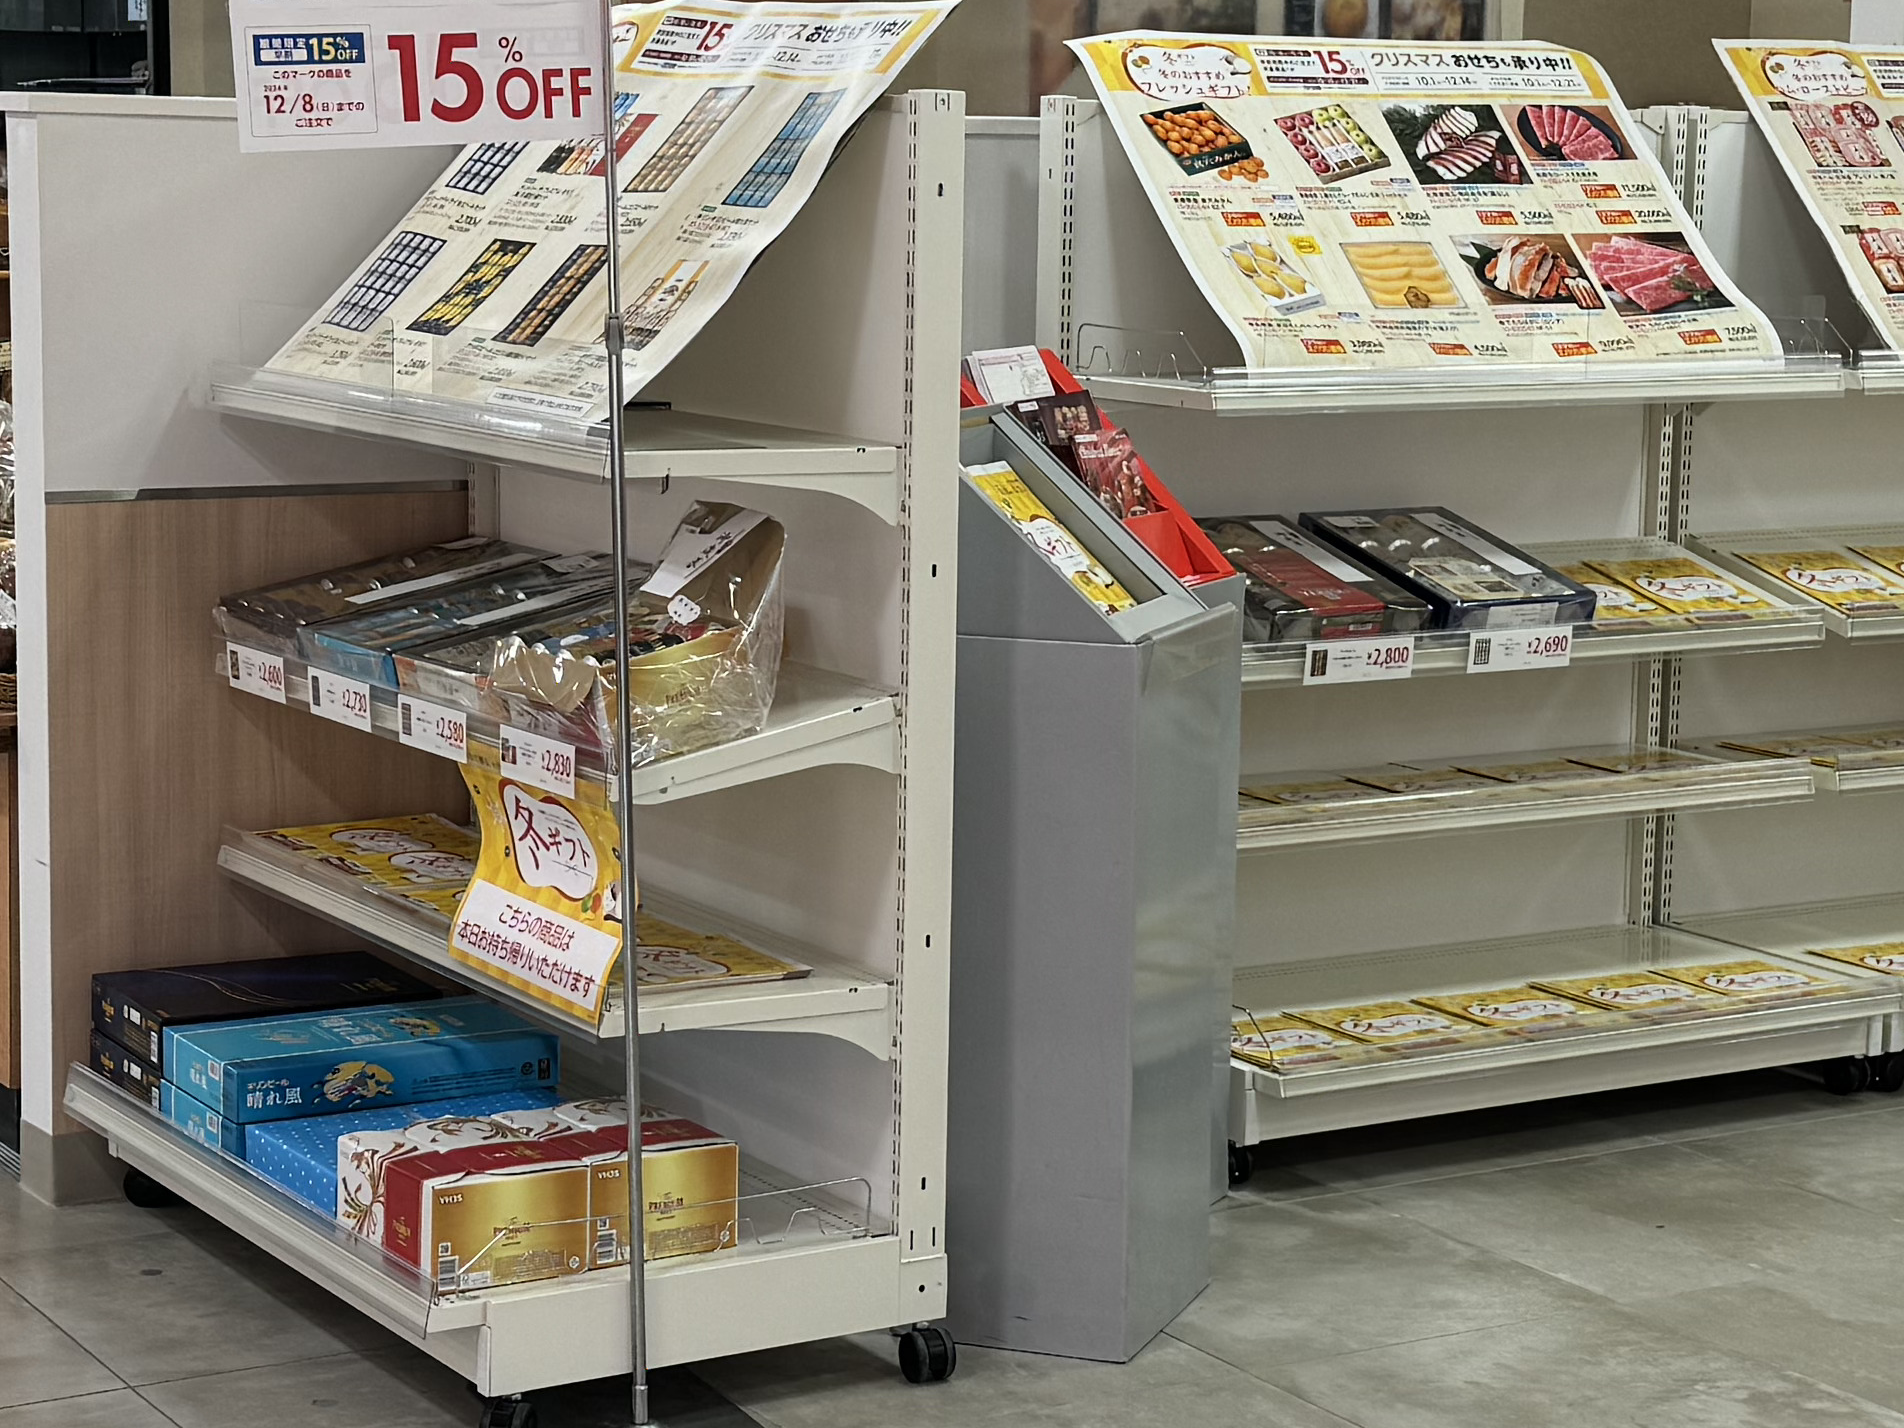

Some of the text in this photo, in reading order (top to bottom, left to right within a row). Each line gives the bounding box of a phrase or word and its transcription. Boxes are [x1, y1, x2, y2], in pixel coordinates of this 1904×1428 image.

[1140, 81, 1252, 98] フレッシュギフト!
[1158, 68, 1226, 81] 冬のおすすめ
[512, 794, 592, 872] 冬ギフト
[497, 904, 576, 951] こちらの商品は
[457, 919, 597, 999] 本日お持ち帰りいただけます
[246, 1086, 303, 1110] 晴れ風
